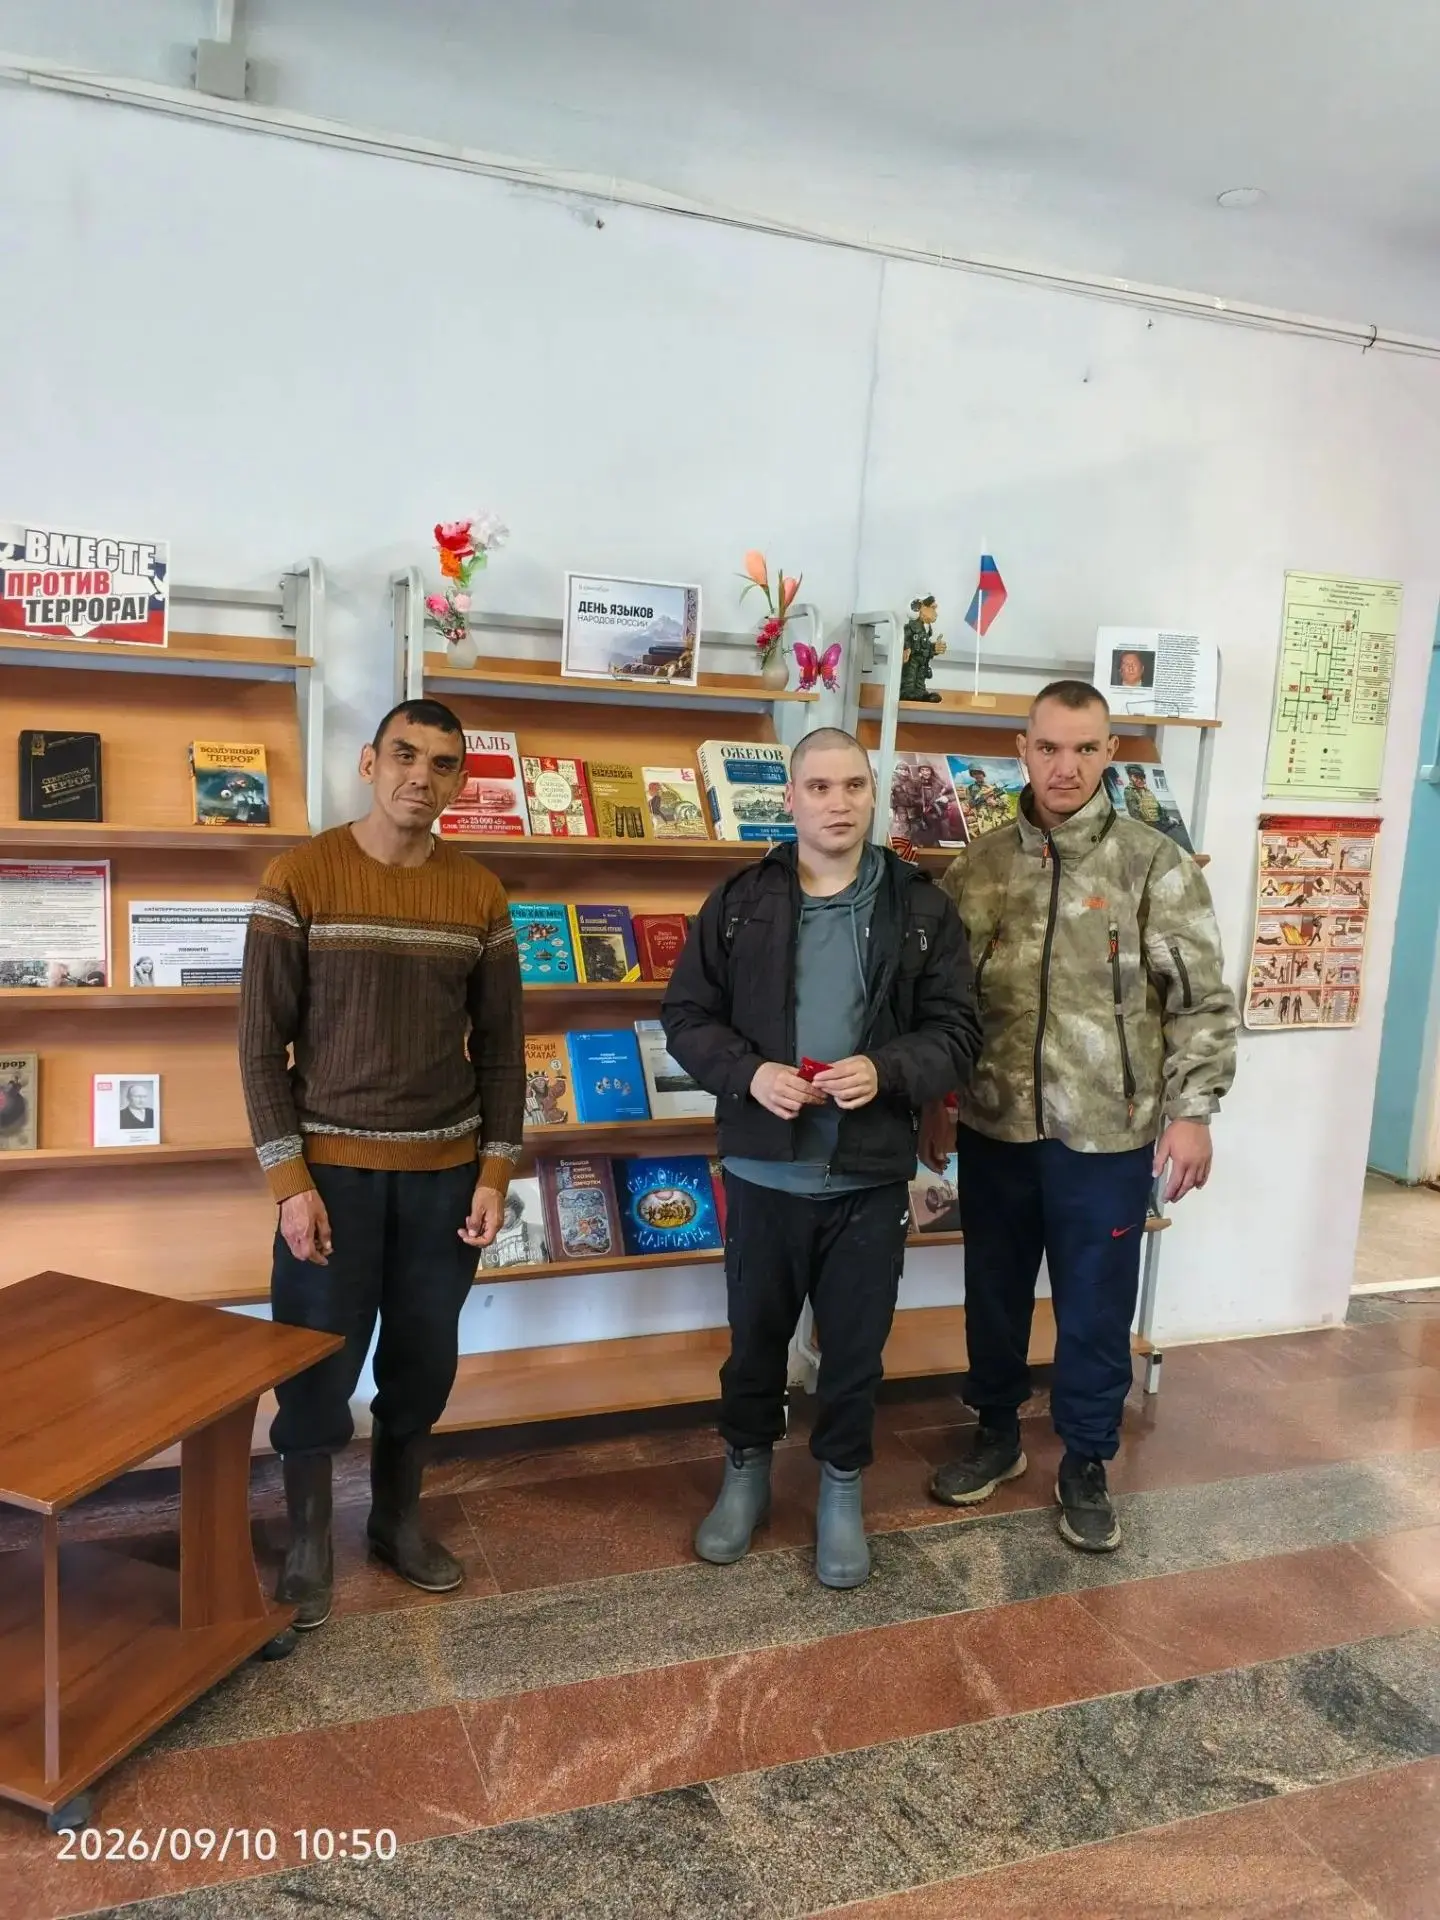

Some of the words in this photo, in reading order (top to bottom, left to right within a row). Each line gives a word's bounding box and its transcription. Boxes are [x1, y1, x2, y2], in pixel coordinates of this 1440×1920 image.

[24, 529, 156, 577] ВМЕСТЕ
[8, 571, 110, 596] ПРОТИВ
[26, 597, 146, 623] ТЕРРОРА!
[578, 600, 608, 614] ДЕНЬ
[610, 604, 654, 618] ЯЗЫКОВ
[578, 614, 615, 625] НАРОДОВ
[616, 618, 649, 628] РОССИИ
[200, 746, 260, 755] ВОЗДУШНЫЙ
[207, 754, 254, 763] ТЕРРОР
[720, 746, 784, 761] ОЖЕГОВ
[42, 774, 91, 794] ТЕРРОР
